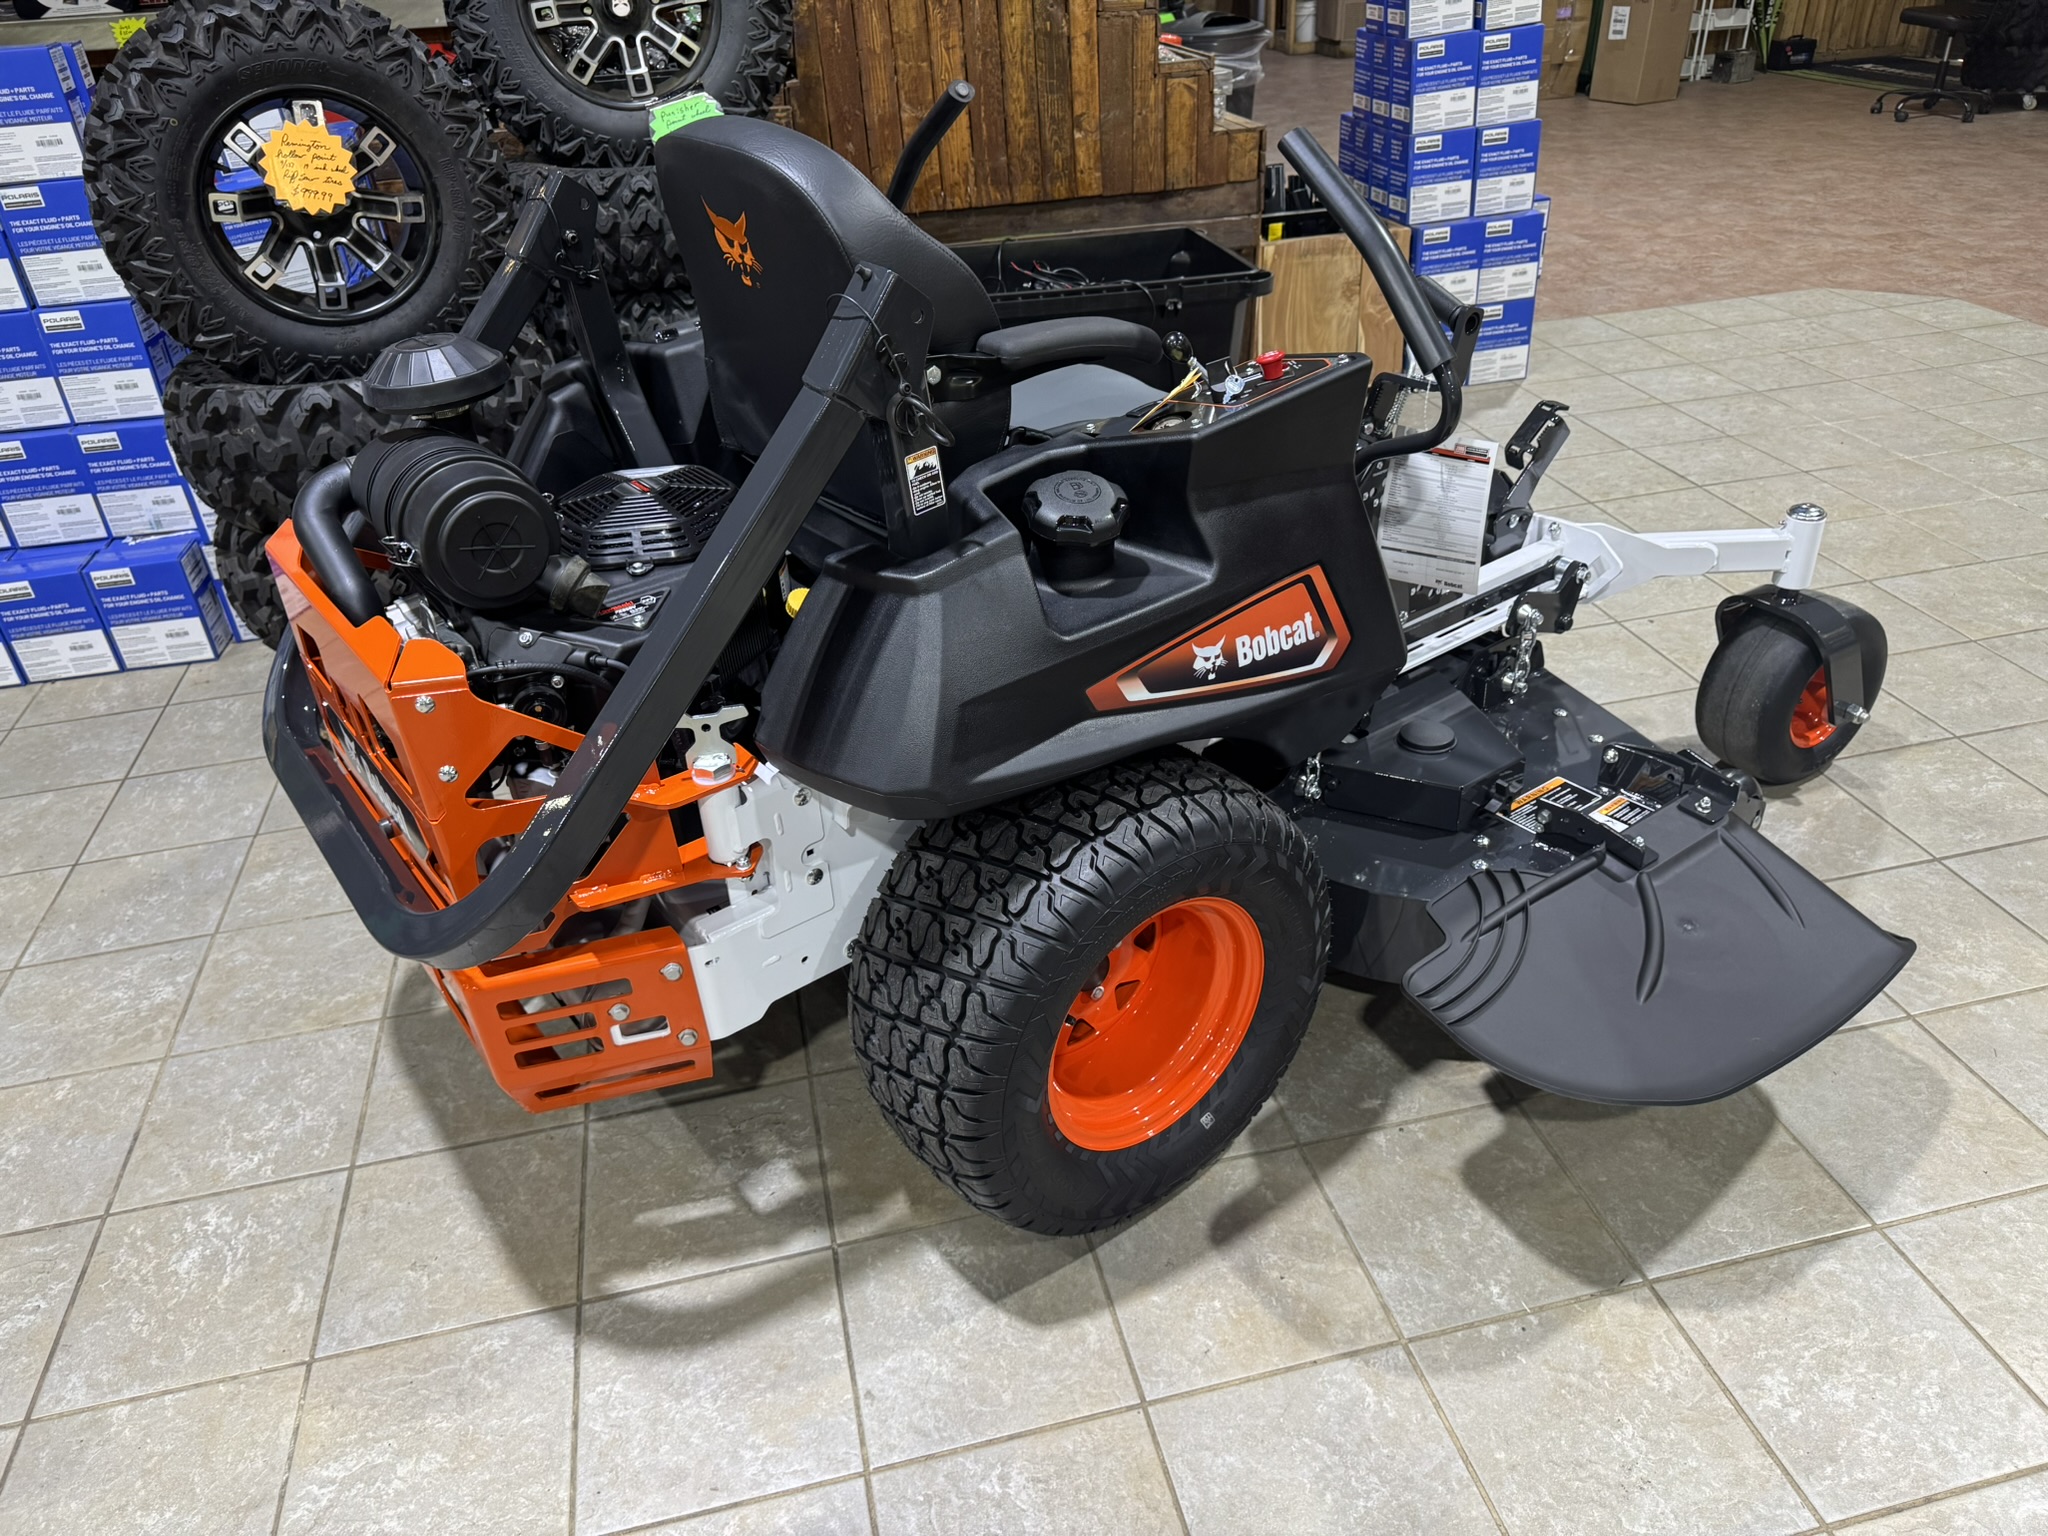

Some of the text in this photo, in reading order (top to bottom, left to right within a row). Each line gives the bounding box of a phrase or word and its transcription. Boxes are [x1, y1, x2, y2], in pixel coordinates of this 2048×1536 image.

[1, 191, 40, 200] POLARIS
[43, 316, 80, 324] POLARIS
[0, 586, 29, 594] OLARIS
[1235, 611, 1314, 668] Bobcat
[1516, 786, 1550, 806] WARNING
